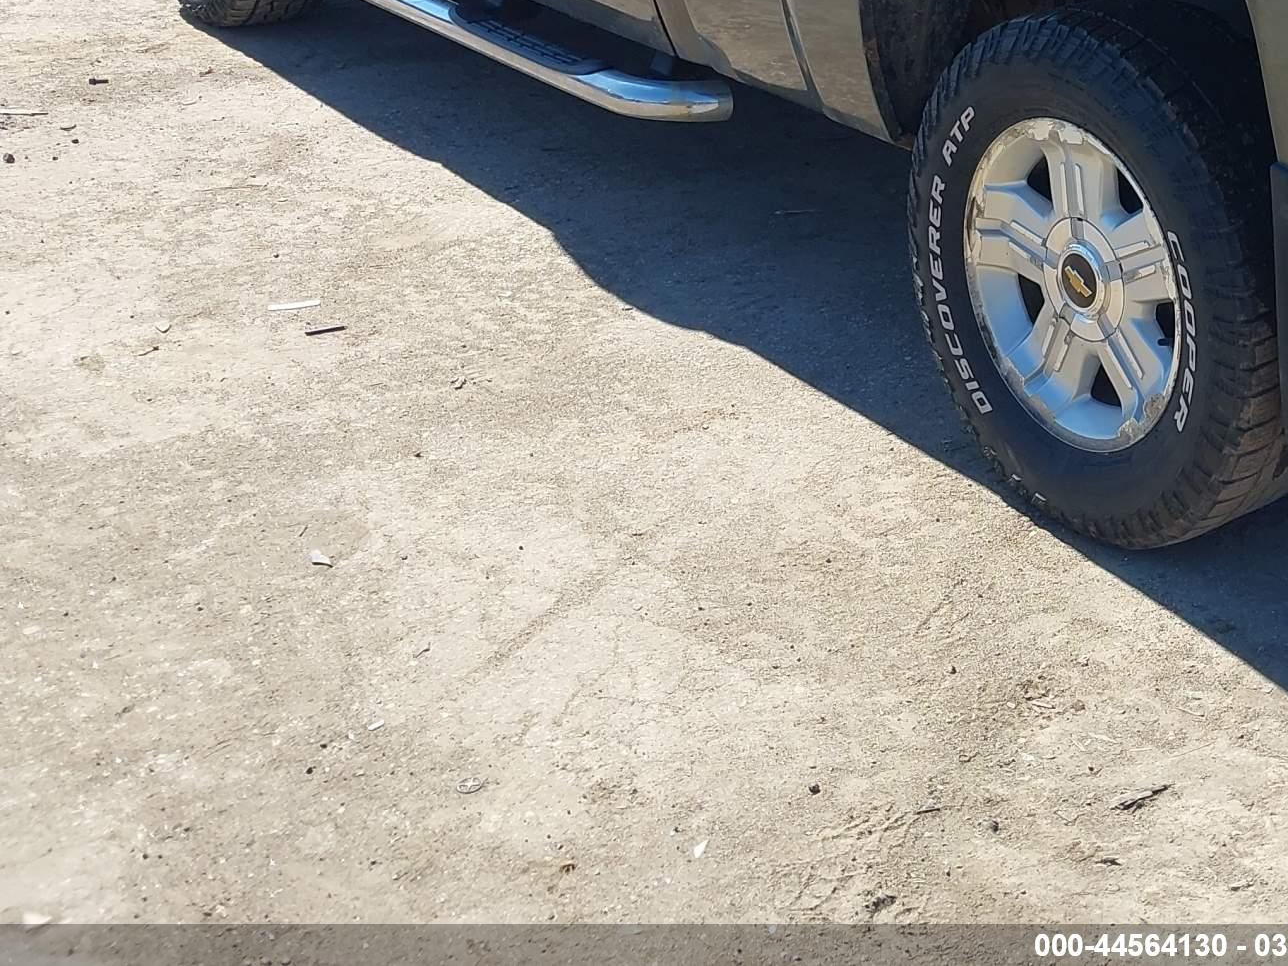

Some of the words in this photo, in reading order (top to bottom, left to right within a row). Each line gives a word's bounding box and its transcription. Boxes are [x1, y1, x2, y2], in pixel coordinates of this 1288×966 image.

[942, 106, 976, 167] ATP
[928, 174, 993, 415] DISCOVERER
[1166, 230, 1197, 433] COOPER
